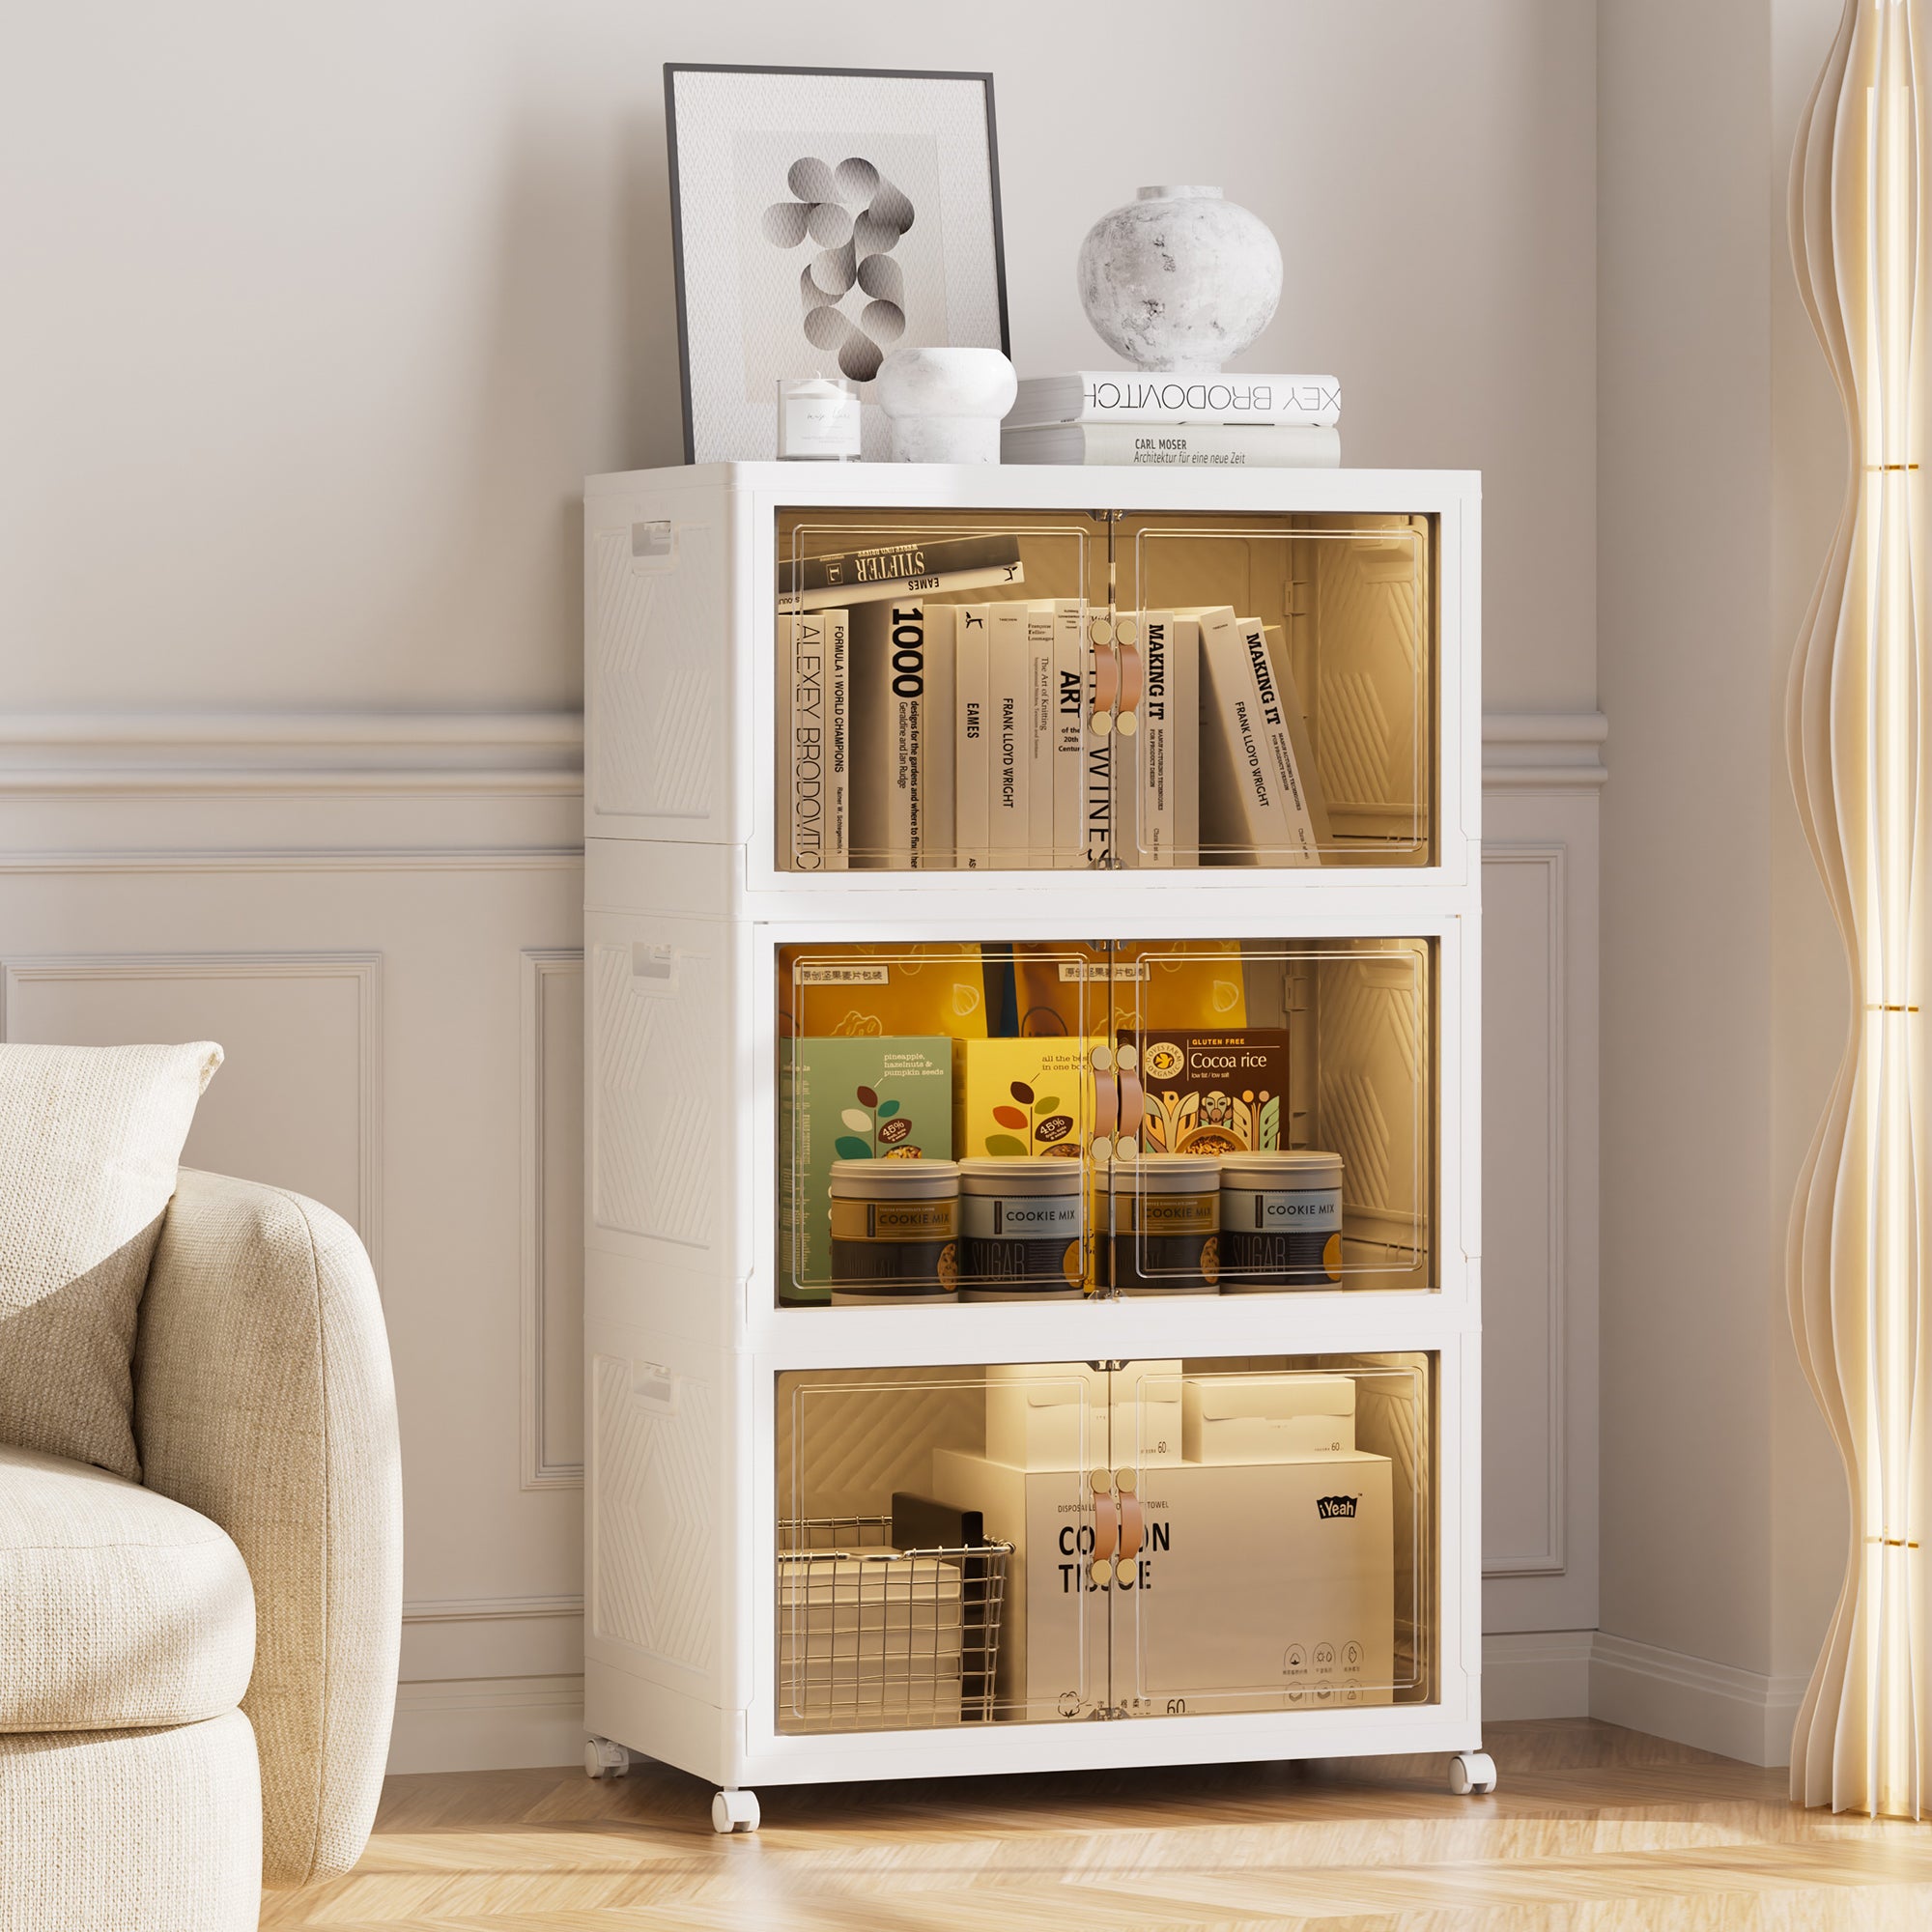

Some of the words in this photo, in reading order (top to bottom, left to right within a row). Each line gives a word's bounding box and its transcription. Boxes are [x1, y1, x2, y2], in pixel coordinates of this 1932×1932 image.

[1135, 439, 1156, 450] CARL
[1159, 439, 1187, 450] MOSER
[1134, 451, 1178, 464] Architektur
[1179, 451, 1190, 463] für
[1192, 451, 1208, 464] eine
[1210, 454, 1229, 464] neue
[1230, 451, 1245, 464] Zeit
[856, 551, 925, 582] STIFTER
[908, 577, 939, 591] EAMES
[834, 626, 844, 671] FORMULA
[893, 608, 924, 698] 1000
[1040, 657, 1049, 672] The
[1149, 624, 1164, 696] MAKING
[796, 624, 821, 719] ALEXEY
[1040, 673, 1049, 687] Art
[1246, 633, 1275, 704] MAKING
[1264, 707, 1281, 724] IT
[834, 681, 844, 715] WORLD
[1060, 670, 1081, 718] ART
[899, 701, 909, 736] Geraldine
[909, 700, 920, 729] designs
[967, 703, 980, 738] EAMES
[1003, 697, 1013, 730] FRANK
[1039, 698, 1049, 731] Knitting
[1149, 702, 1164, 720] IT
[1236, 701, 1251, 734] FRANK
[834, 717, 844, 773] CHAMPIONS
[899, 737, 909, 751] and
[910, 730, 920, 741] for
[899, 753, 909, 764] Ian
[910, 742, 920, 755] the
[1003, 733, 1013, 766] LLOYD
[1243, 735, 1259, 767] LLOYD
[897, 765, 909, 789] Rudge
[908, 756, 920, 785] gardens
[910, 787, 920, 802] and
[1003, 767, 1014, 809] WRIGHT
[1252, 768, 1269, 807] WRIGHT
[910, 803, 920, 825] where
[910, 826, 920, 835] to
[884, 1052, 925, 1061] pineapple,
[1190, 1052, 1236, 1068] Cocoa
[1240, 1052, 1267, 1067] rice
[1148, 1065, 1180, 1078] ORGANIC
[882, 1122, 905, 1137] 45%
[1039, 1119, 1065, 1135] 45%
[879, 1214, 928, 1225] COOKIE
[932, 1213, 950, 1223] MIX
[1006, 1211, 1056, 1221] COOKIE
[1059, 1209, 1075, 1220] MIX
[1267, 1206, 1315, 1215] COOKIE
[1319, 1205, 1334, 1214] MIX
[972, 1242, 1025, 1282] SUGAR
[1233, 1236, 1286, 1273] SUGAR
[1158, 1441, 1167, 1454] 60
[1331, 1442, 1340, 1451] 60
[1320, 1500, 1354, 1517] iYeah
[1167, 1698, 1185, 1714] 60
